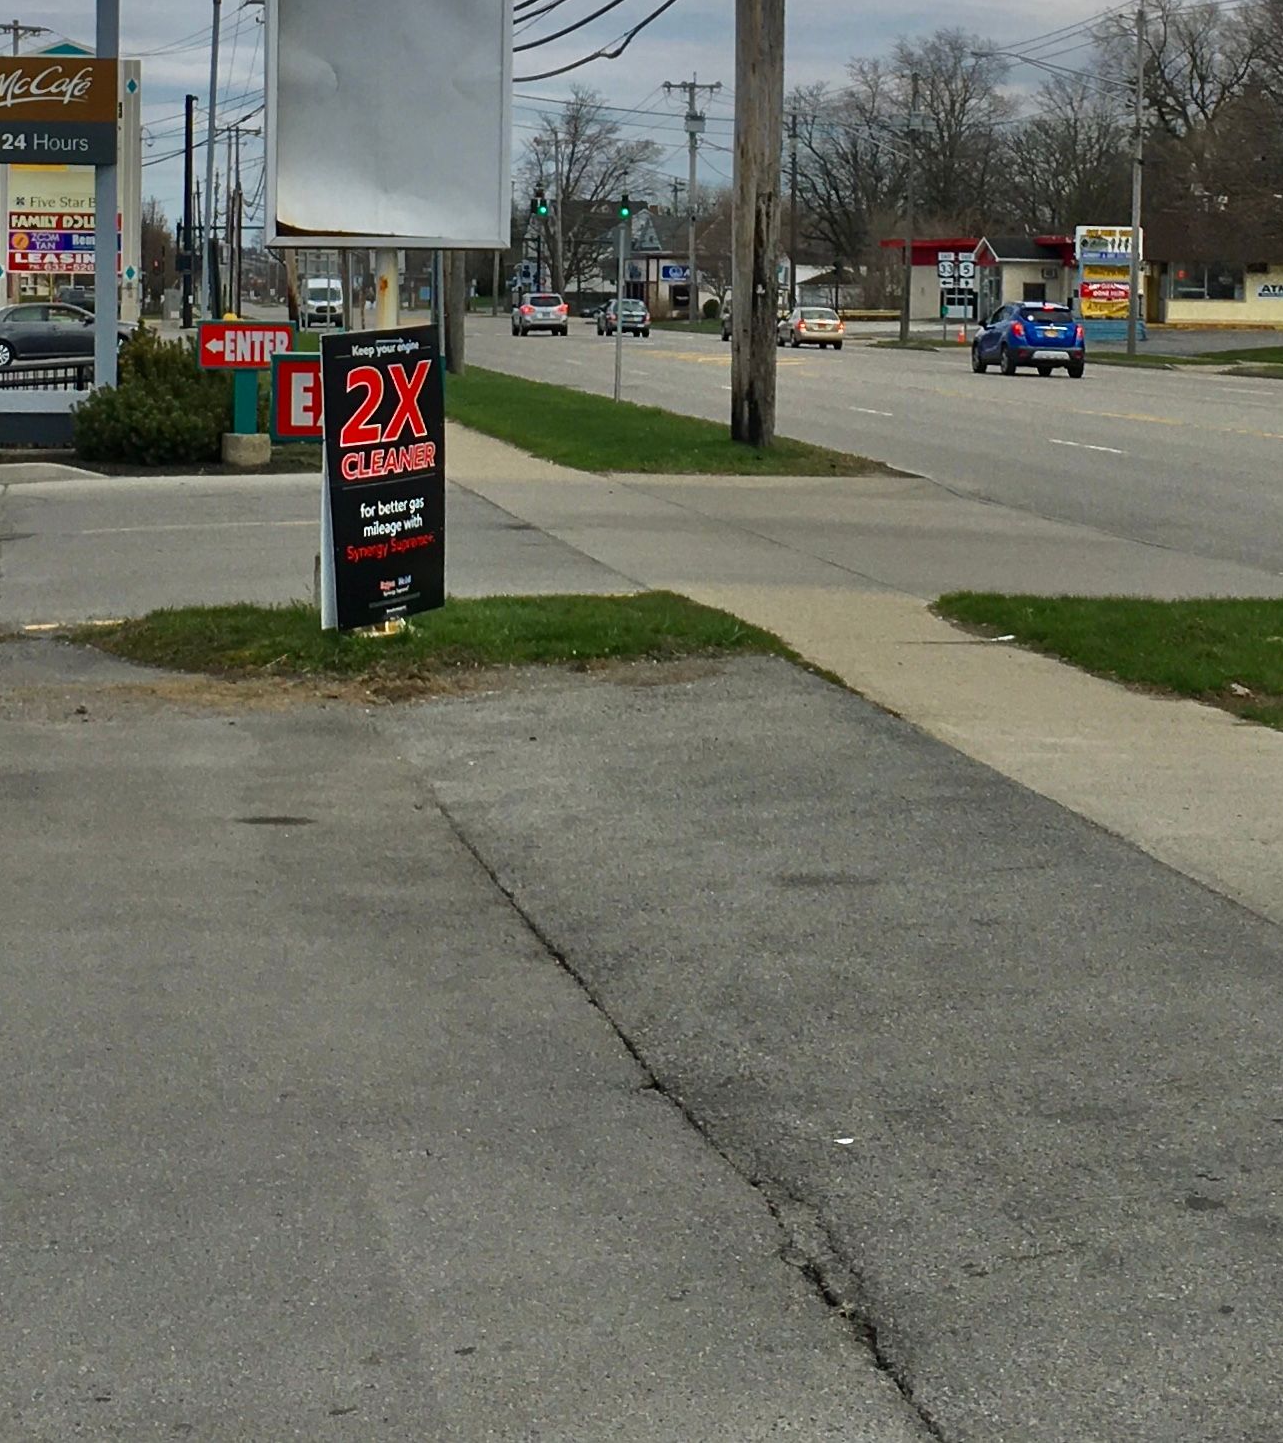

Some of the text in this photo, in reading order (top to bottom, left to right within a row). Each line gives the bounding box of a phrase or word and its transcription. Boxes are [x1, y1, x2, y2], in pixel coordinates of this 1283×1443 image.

[2, 133, 89, 152] 24 Hours
[30, 197, 56, 208] Five
[59, 197, 85, 208] Star
[11, 215, 96, 228] FAMILY DOLL
[35, 242, 56, 250] TAN
[14, 252, 96, 264] LEASIN
[940, 263, 954, 274] 33
[963, 264, 970, 275] 5
[224, 330, 289, 362] ENTER
[351, 339, 420, 358] Keep your engine
[339, 359, 432, 448] 2X
[341, 441, 436, 481] CLEANER
[360, 496, 425, 519] for better gas
[363, 513, 423, 537] mileage with
[346, 542, 388, 563] Synergy
